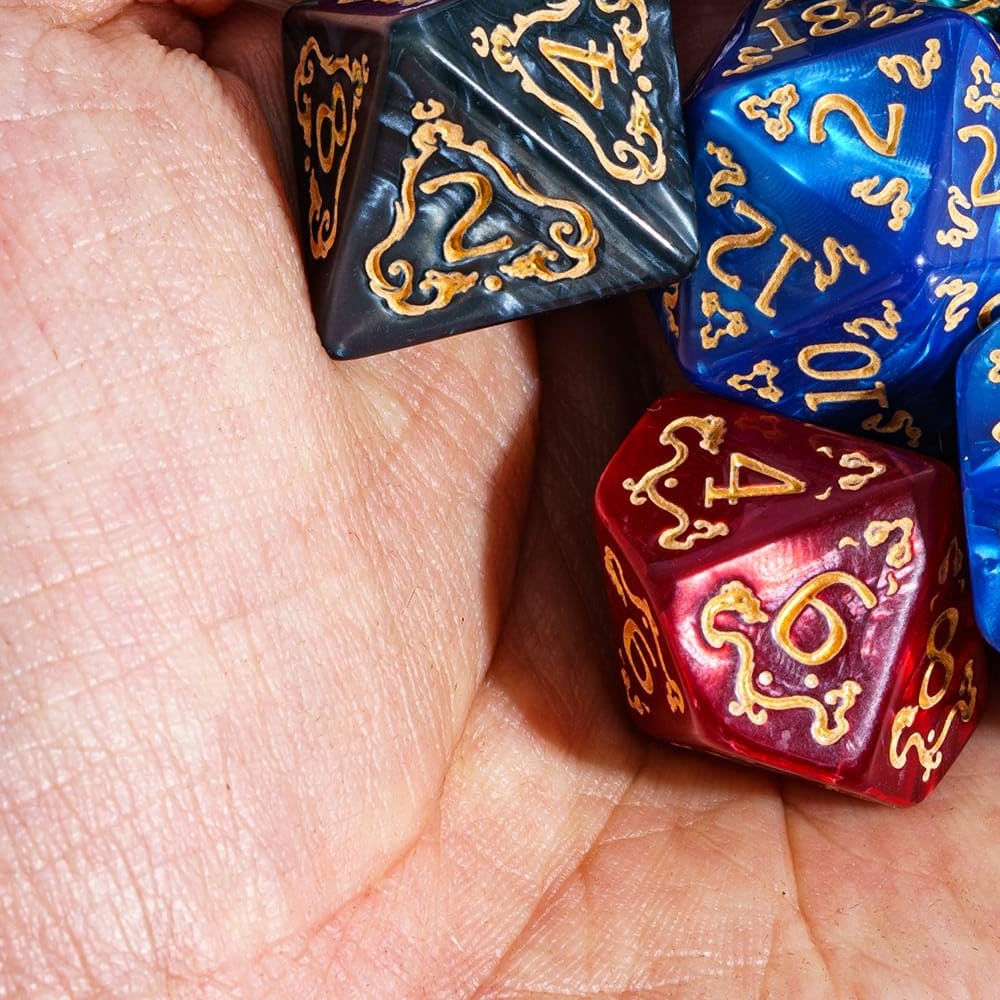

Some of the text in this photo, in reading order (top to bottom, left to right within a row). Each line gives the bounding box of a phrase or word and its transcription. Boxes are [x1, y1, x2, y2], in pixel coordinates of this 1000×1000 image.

[538, 36, 619, 110] 4
[316, 82, 347, 174] 8
[810, 93, 905, 157] 2
[418, 170, 513, 263] 2
[706, 200, 812, 318] 12
[797, 343, 890, 412] 10
[705, 452, 807, 508] 4
[918, 607, 960, 711] 8
